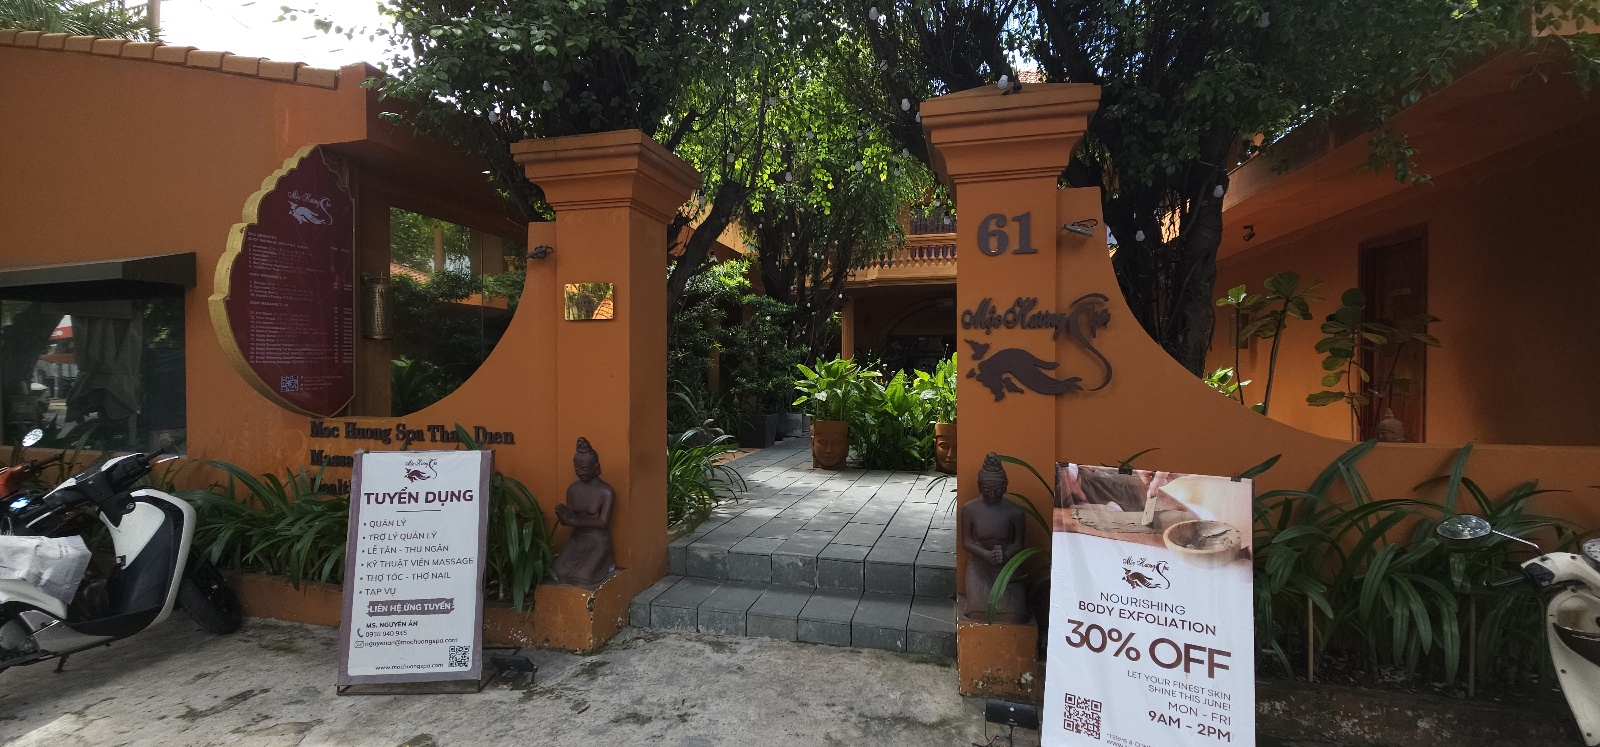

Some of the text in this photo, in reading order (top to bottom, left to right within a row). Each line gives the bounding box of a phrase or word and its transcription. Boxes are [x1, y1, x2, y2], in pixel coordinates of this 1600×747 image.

[977, 211, 1038, 256] 61
[310, 420, 340, 439] Moc
[344, 421, 392, 444] Huong
[395, 423, 425, 445] Spa
[310, 449, 354, 468] Massa
[364, 486, 474, 507] TUYỂN DỤNG
[396, 518, 407, 527] LÝ
[369, 532, 386, 542] TRỢ
[388, 531, 399, 540] LÝ
[426, 530, 438, 539] LÝ
[404, 545, 422, 554] THU
[432, 557, 474, 566] MASSAGE
[386, 572, 403, 581] TÓC
[431, 571, 451, 579] NAIL
[384, 588, 397, 597] VỤ
[1100, 591, 1186, 616] NOURISHING
[1078, 600, 1217, 636] BODY EXFOLIATION
[1065, 618, 1232, 679] 30% OFF
[1127, 670, 1231, 702] LET YOUR FINEST SKIN
[1148, 684, 1231, 712] SHINE THIS JUNE!
[1168, 701, 1199, 717] MON
[1211, 713, 1231, 726] FRI
[1148, 710, 1181, 729] 9AM
[1197, 723, 1231, 743] 2PM
